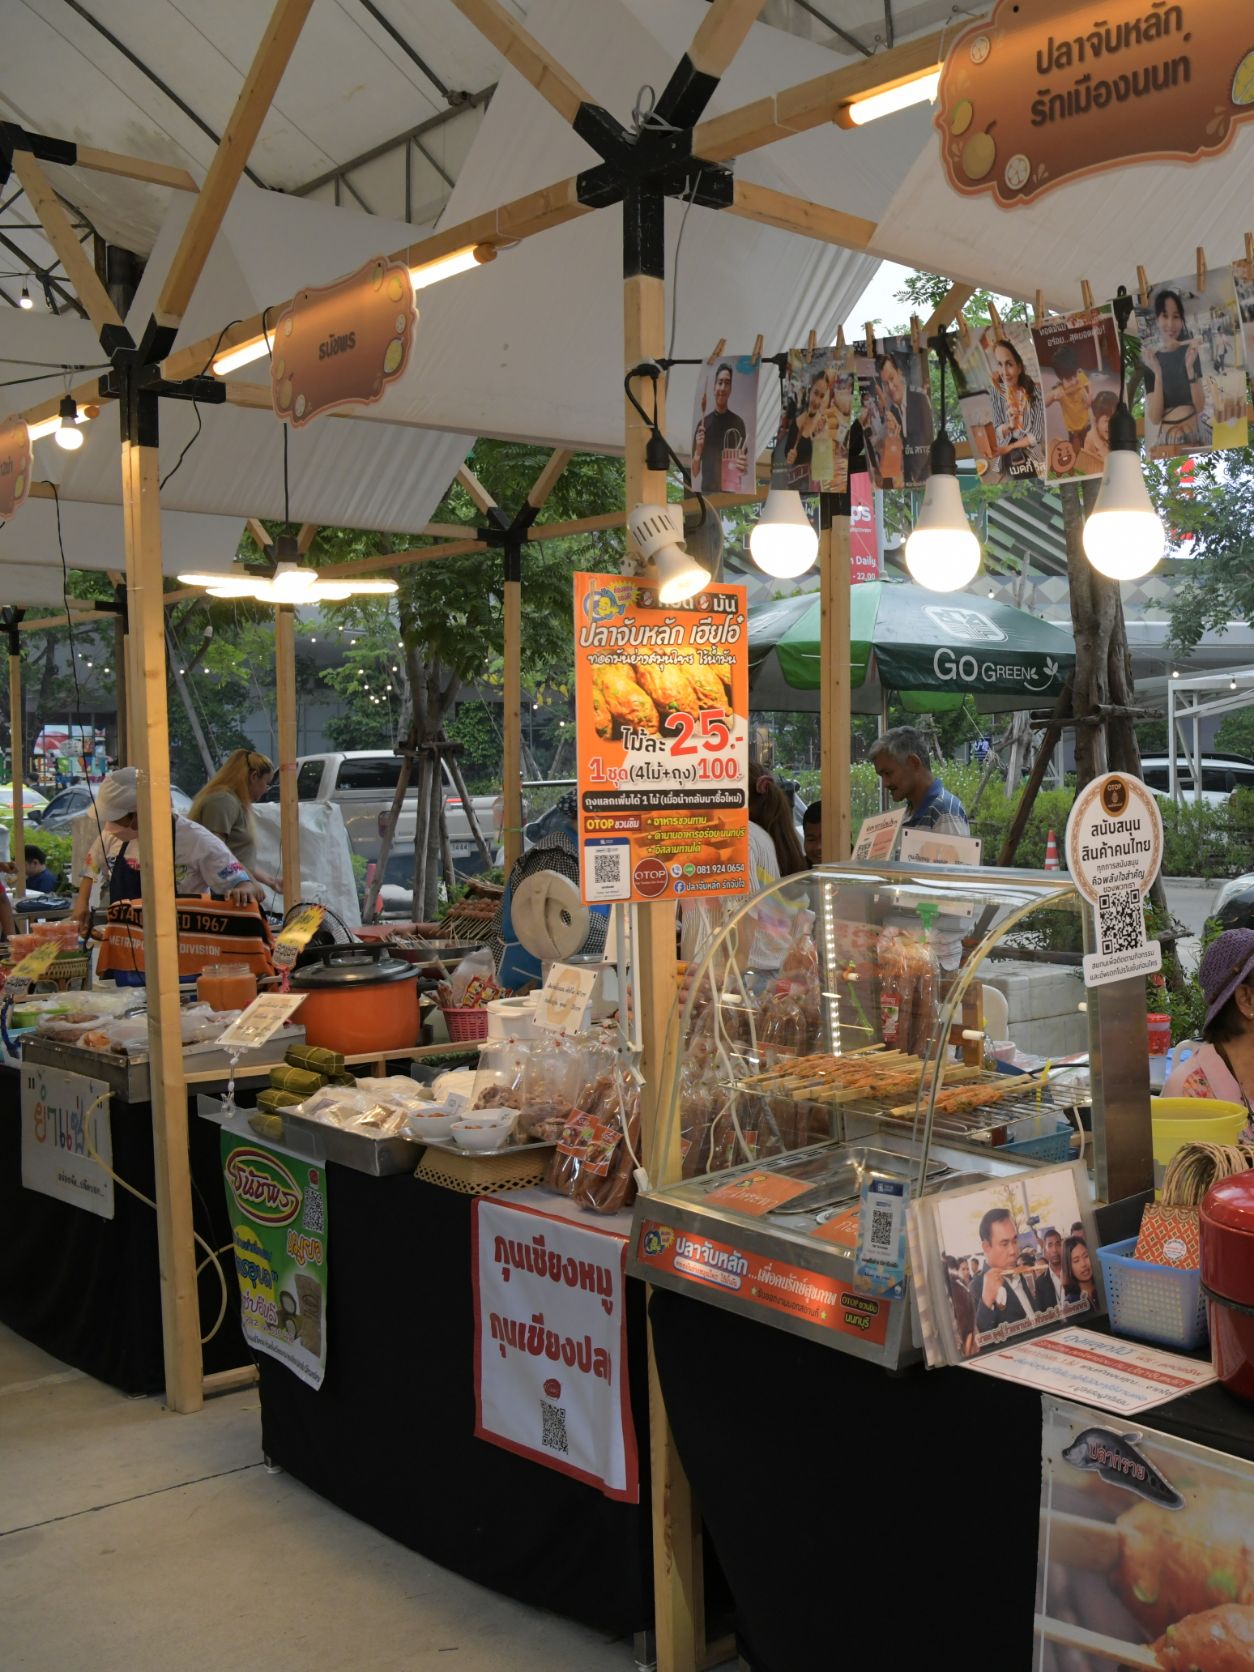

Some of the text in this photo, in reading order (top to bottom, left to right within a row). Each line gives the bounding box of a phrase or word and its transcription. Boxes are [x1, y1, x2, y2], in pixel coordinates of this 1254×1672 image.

[1036, 1, 1184, 75] ปลาจับหลัก
[1031, 32, 1193, 127] รักเมืองนนท์
[856, 555, 876, 568] Daily
[579, 616, 685, 647] ปลาจับหลัก
[933, 647, 1031, 682] GO GREEN
[620, 725, 666, 753] ไม้ละ
[586, 817, 640, 830] OTOP ชวนชิม
[1091, 818, 1141, 837] สนับสนุน
[1081, 837, 1151, 861] สินค้าคนไทย
[634, 869, 666, 880] OTOP
[696, 863, 745, 875] 081 924 0654
[1091, 868, 1146, 887] คือพลังใจสำคัญ
[1103, 881, 1137, 893] ของพวกเรา
[196, 914, 229, 932] 1967
[179, 943, 221, 956] DIVISION
[675, 1236, 749, 1277] ปลาจับหลัก
[494, 1234, 613, 1316] กุนเชียงหมู
[489, 1311, 612, 1387] กุนเชียงปลา
[1088, 1442, 1146, 1481] ปลากราย
